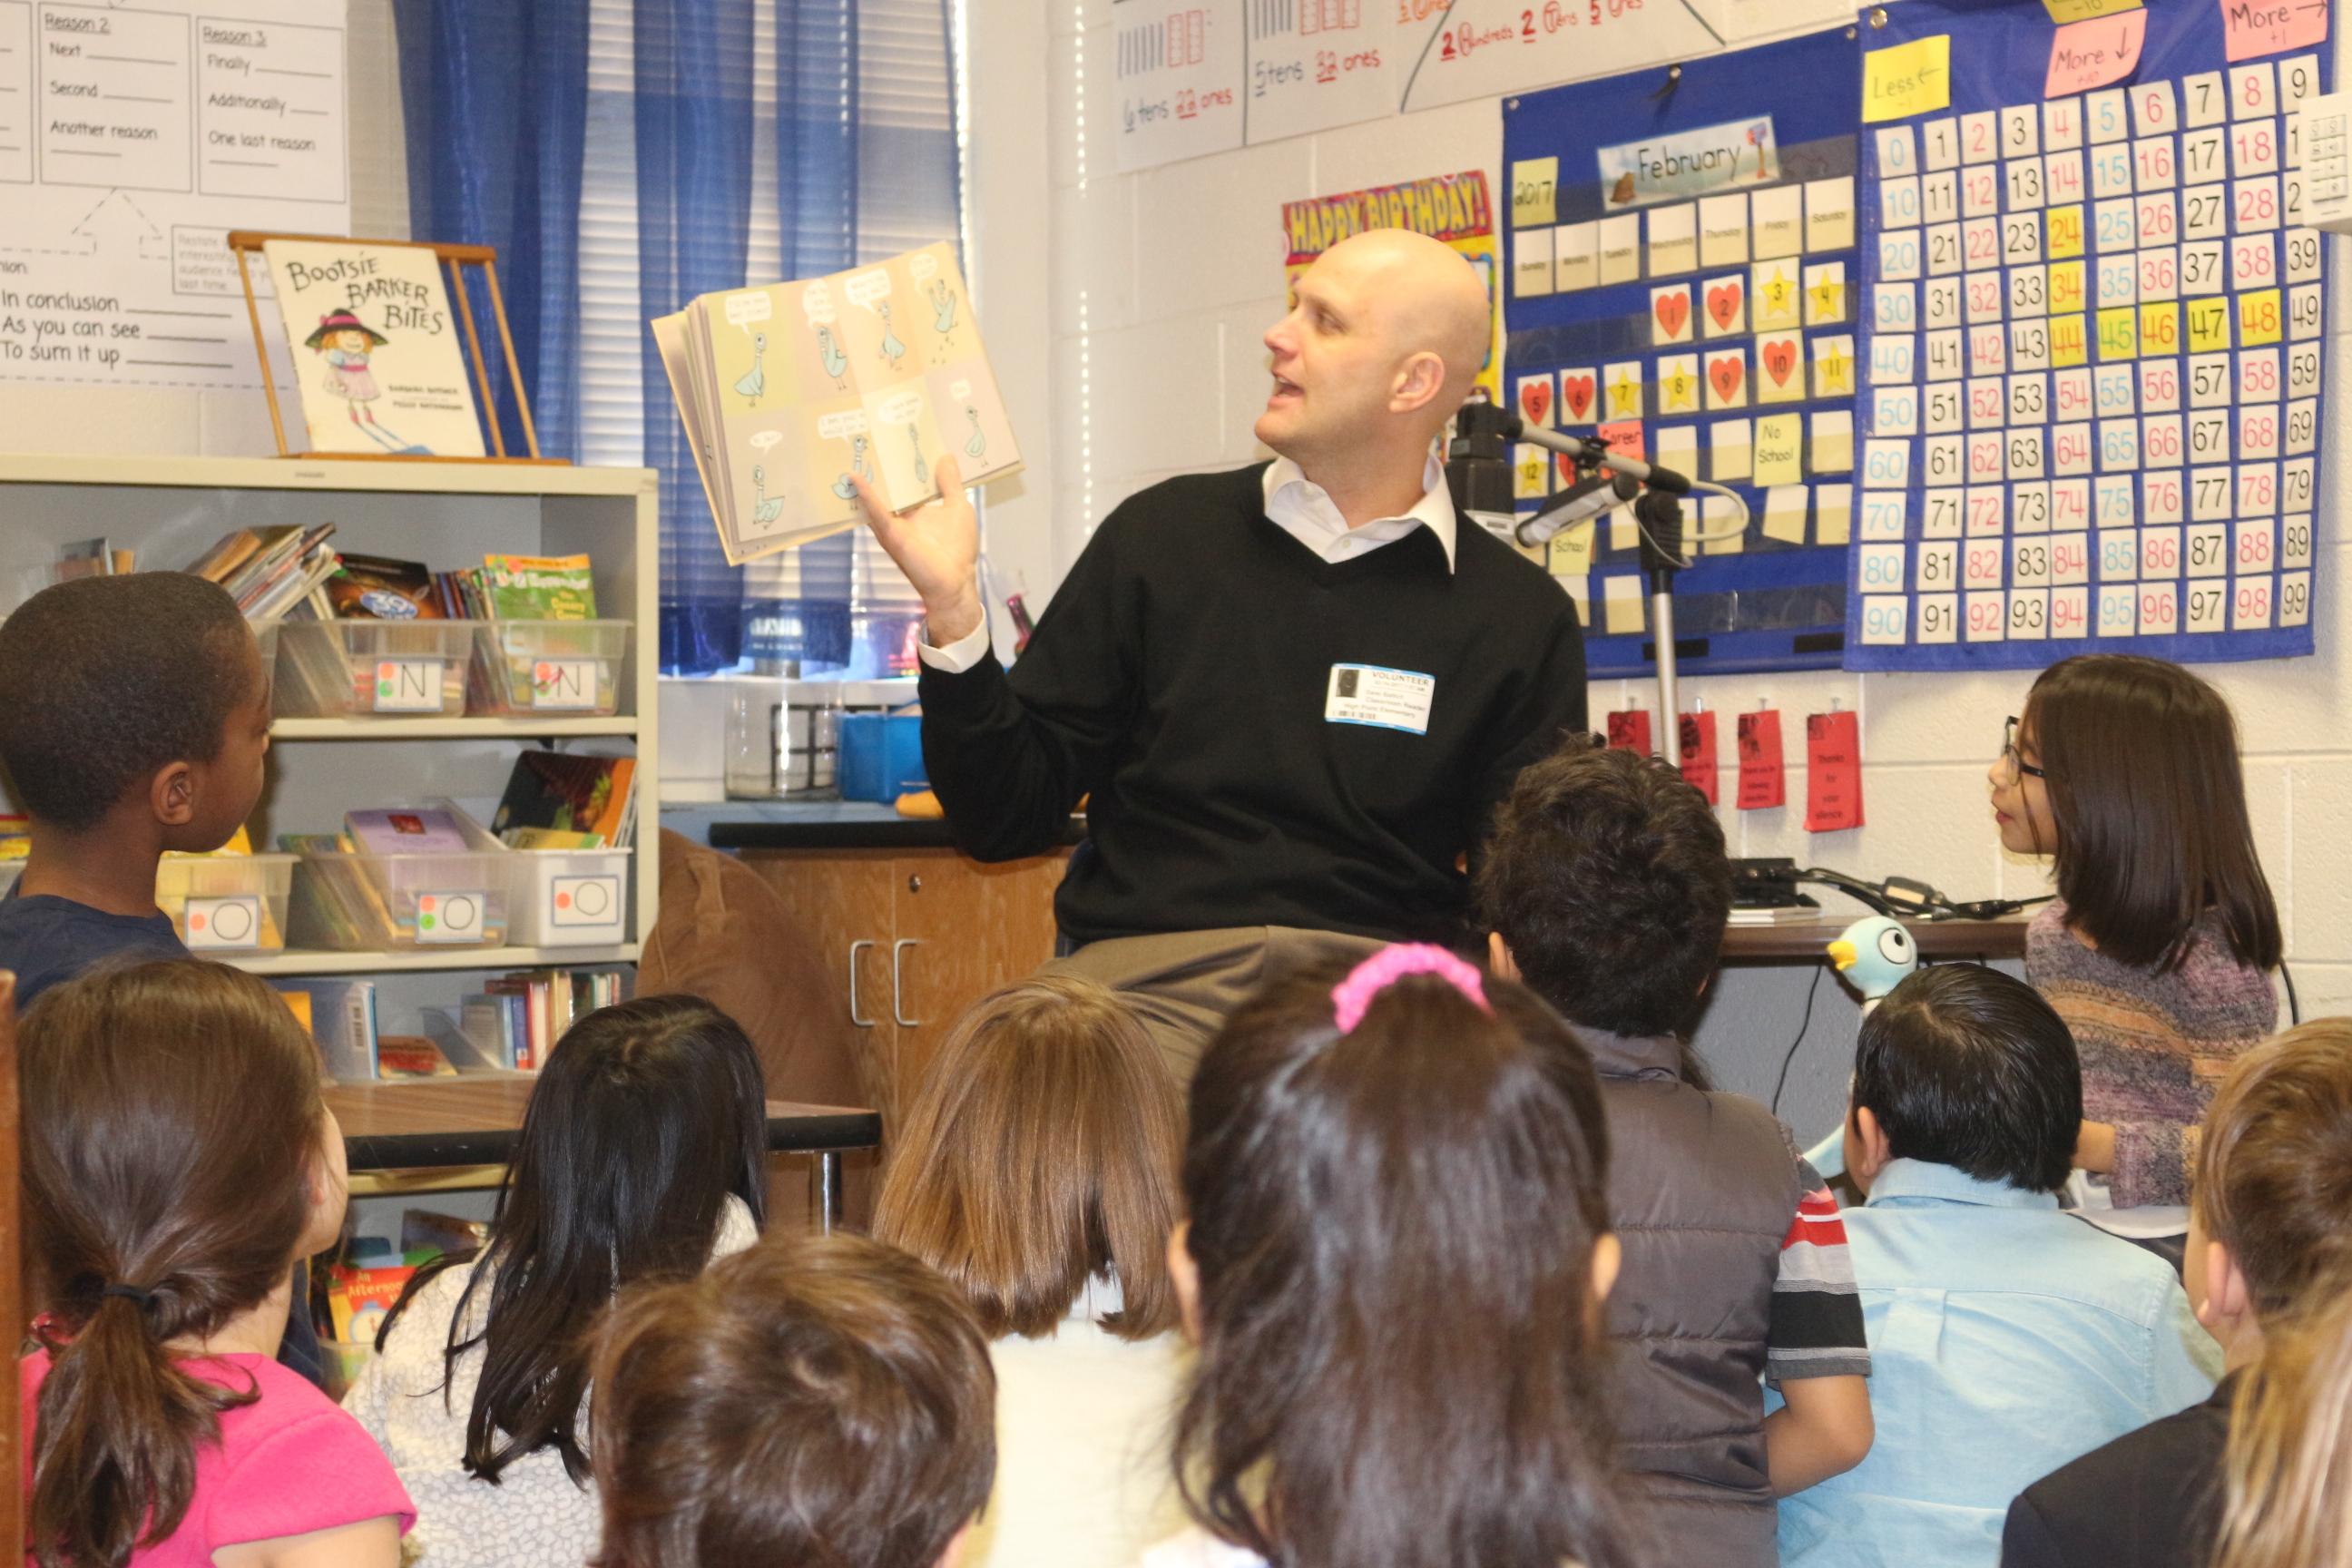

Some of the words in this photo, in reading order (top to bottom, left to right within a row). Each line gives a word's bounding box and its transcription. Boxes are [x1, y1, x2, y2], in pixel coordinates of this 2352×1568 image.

[45, 14, 94, 32] Reason
[100, 18, 111, 33] 2
[2230, 5, 2292, 33] More
[50, 42, 81, 56] Next
[203, 26, 252, 45] Reason
[255, 30, 266, 46] 3
[1442, 32, 1456, 61] 2
[1521, 9, 1536, 42] 2
[208, 54, 250, 74] Finally
[1255, 60, 1267, 90] 5
[1268, 62, 1304, 85] tens
[1344, 49, 1381, 71] ones
[2054, 48, 2105, 74] More
[50, 80, 98, 98] Second
[1873, 73, 1916, 101] Less
[208, 93, 286, 116] Additionally
[1138, 100, 1169, 122] tens
[1201, 88, 1232, 108] ones
[1890, 139, 1904, 167] 0
[1936, 132, 1945, 158] 1
[1973, 123, 1985, 152] 2
[2014, 117, 2025, 145] 3
[2054, 110, 2069, 137] 4
[2101, 102, 2114, 132] 5
[2146, 93, 2162, 122] 6
[2196, 83, 2210, 113] 7
[2245, 76, 2261, 106] 8
[2292, 68, 2307, 98] 9
[50, 120, 106, 139] Another
[111, 125, 157, 141] reason
[209, 130, 236, 146] One
[240, 132, 264, 148] last
[271, 138, 316, 152] reason
[1638, 145, 1741, 181] February
[1887, 189, 1916, 217] 10
[1929, 182, 1950, 211] 11
[1967, 174, 1994, 205] 12
[2012, 169, 2039, 199] 13
[2052, 162, 2078, 192] 14
[2097, 156, 2127, 186] 15
[2139, 148, 2170, 179] 16
[2189, 140, 2218, 172] 17
[2236, 132, 2270, 165] 18
[1514, 181, 1553, 207] 2017
[1290, 199, 1362, 254] HAPPY
[1367, 177, 1487, 232] BIRTHDAY!
[1650, 236, 1695, 250] Wednesday
[1705, 227, 1742, 240] Thursday
[1765, 220, 1789, 232] Friday
[1812, 209, 1847, 224] Saturday
[1884, 240, 1917, 272] 20
[1934, 235, 1955, 264] 21
[1968, 228, 1996, 259] 22
[2008, 222, 2036, 253] 23
[2050, 215, 2082, 246] 24
[2099, 211, 2131, 243] 25
[2141, 204, 2172, 236] 26
[2189, 196, 2220, 228] 27
[2239, 189, 2274, 221] 28
[1877, 295, 1911, 324] 30
[1932, 289, 1954, 317] 31
[1968, 282, 1997, 312] 32
[2014, 276, 2043, 307] 33
[2052, 270, 2082, 302] 34
[2100, 265, 2132, 298] 35
[2141, 260, 2173, 291] 36
[2185, 252, 2218, 283] 37
[2237, 246, 2270, 279] 38
[2288, 238, 2317, 272] 39
[2, 289, 21, 309] In
[26, 291, 120, 313] conclusion
[1669, 306, 1676, 325] 1
[1720, 299, 1730, 318] 2
[1773, 282, 1783, 301] 3
[1820, 286, 1830, 305] 4
[3, 316, 25, 333] As
[33, 319, 65, 343] you
[73, 321, 103, 338] can
[111, 323, 141, 339] see
[1873, 345, 1910, 376] 40
[1932, 341, 1957, 368] 41
[1971, 335, 2001, 366] 42
[2014, 329, 2044, 359] 43
[2052, 326, 2082, 351] 44
[2099, 318, 2132, 350] 45
[2142, 312, 2174, 344] 46
[2190, 309, 2223, 341] 47
[2240, 301, 2277, 332] 48
[2291, 293, 2319, 327] 49
[1, 340, 23, 359] To
[30, 346, 71, 362] sum
[78, 344, 91, 361] it
[98, 348, 120, 370] up
[1532, 395, 1541, 415] 5
[1573, 387, 1583, 407] 6
[1620, 385, 1630, 402] 7
[1674, 377, 1683, 394] 8
[1721, 372, 1730, 388] 9
[1772, 354, 1788, 374] 10
[1828, 358, 1841, 377] 11
[1763, 424, 1781, 441] No
[1758, 447, 1795, 466] School
[1526, 464, 1539, 479] 12
[1555, 540, 1587, 554] School
[1867, 608, 1904, 636] 90
[1925, 604, 1950, 632] 91
[1968, 601, 2000, 632] 92
[2013, 600, 2043, 628] 93
[2053, 597, 2082, 627] 94
[2103, 595, 2133, 626] 95
[2142, 594, 2173, 624] 96
[2190, 590, 2221, 621] 97
[2237, 587, 2269, 619] 98
[2283, 581, 2308, 616] 99
[400, 663, 426, 699] N
[558, 664, 581, 698] N
[1372, 671, 1430, 687] VOLUNTEER
